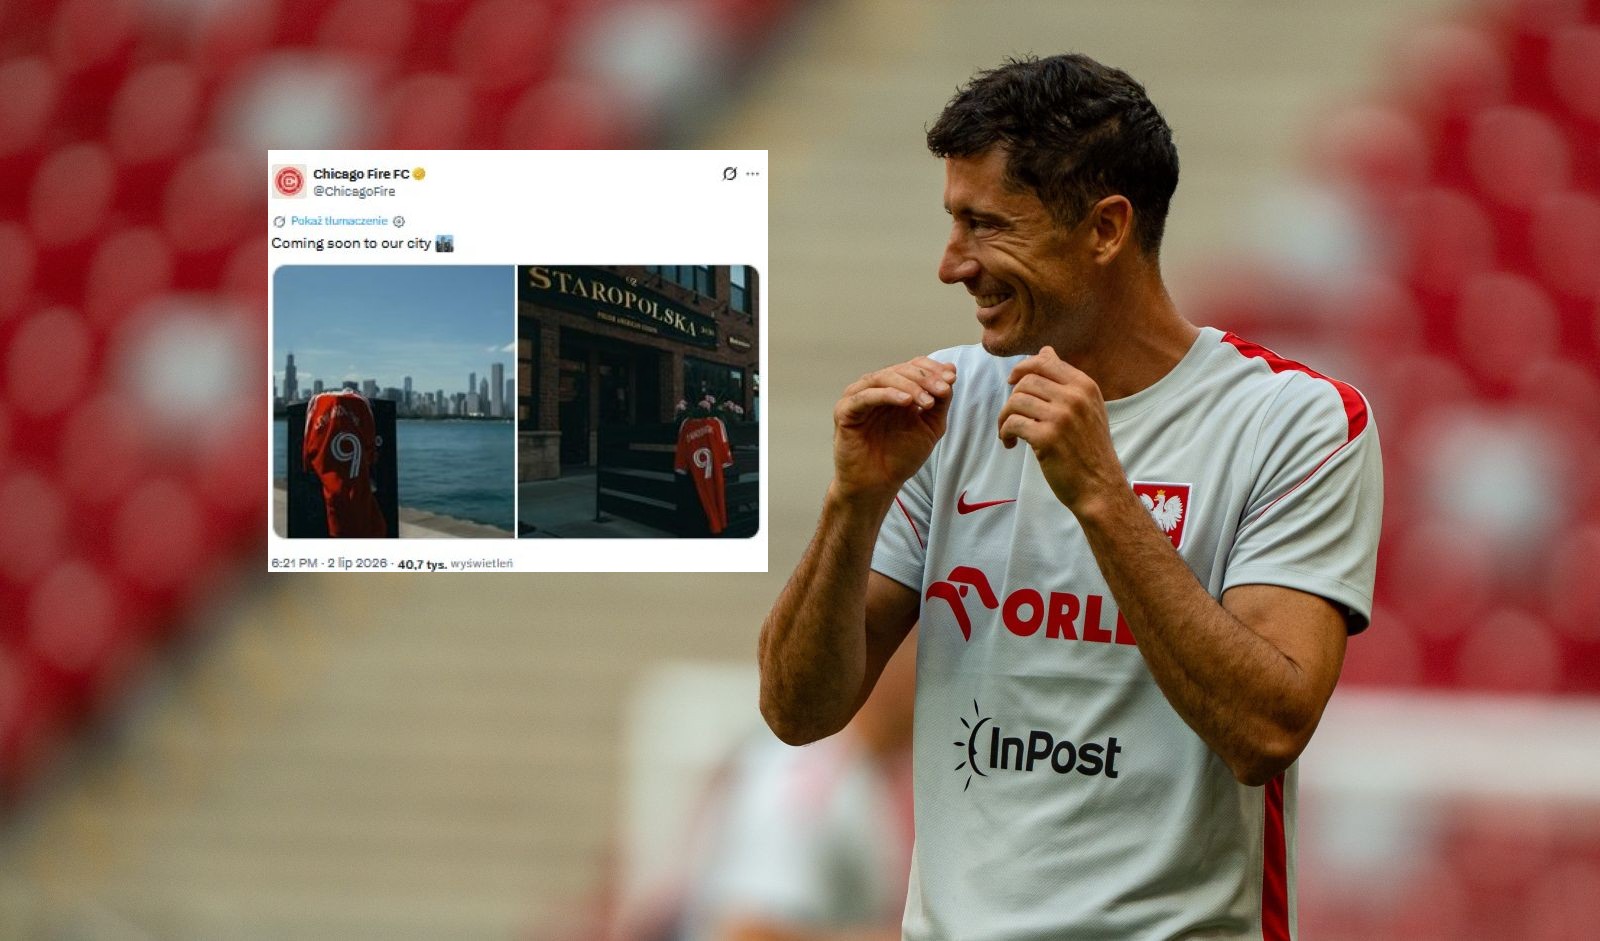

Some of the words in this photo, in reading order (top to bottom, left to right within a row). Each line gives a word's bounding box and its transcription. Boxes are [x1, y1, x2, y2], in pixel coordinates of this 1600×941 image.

[528, 266, 697, 337] STAROPOLSKA
[330, 432, 362, 479] 9
[693, 447, 712, 479] 9
[989, 726, 1122, 779] InPost
